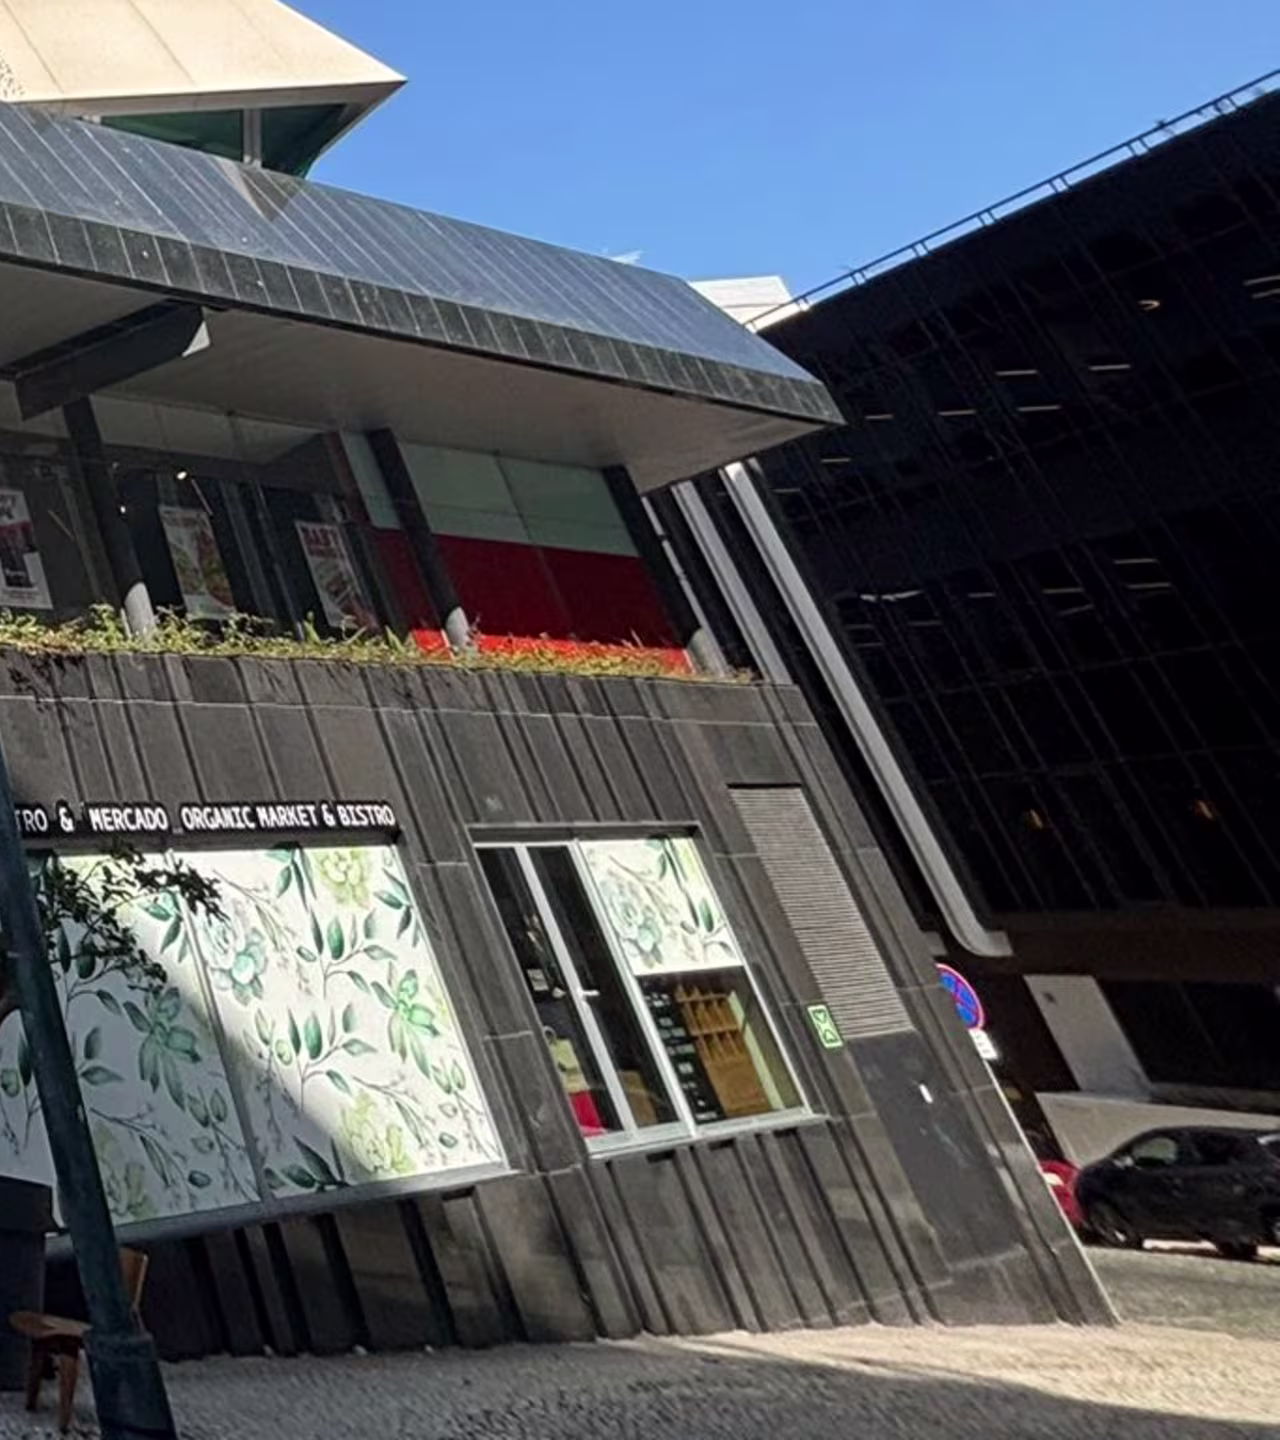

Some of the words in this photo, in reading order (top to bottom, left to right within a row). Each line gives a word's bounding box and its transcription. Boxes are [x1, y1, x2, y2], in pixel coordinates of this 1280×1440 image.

[59, 806, 74, 833] &
[89, 805, 169, 832] MERCADO
[180, 805, 255, 830] ORGANIC
[257, 804, 318, 829] MARKET
[324, 803, 336, 827] &
[338, 804, 395, 827] BISTRO
